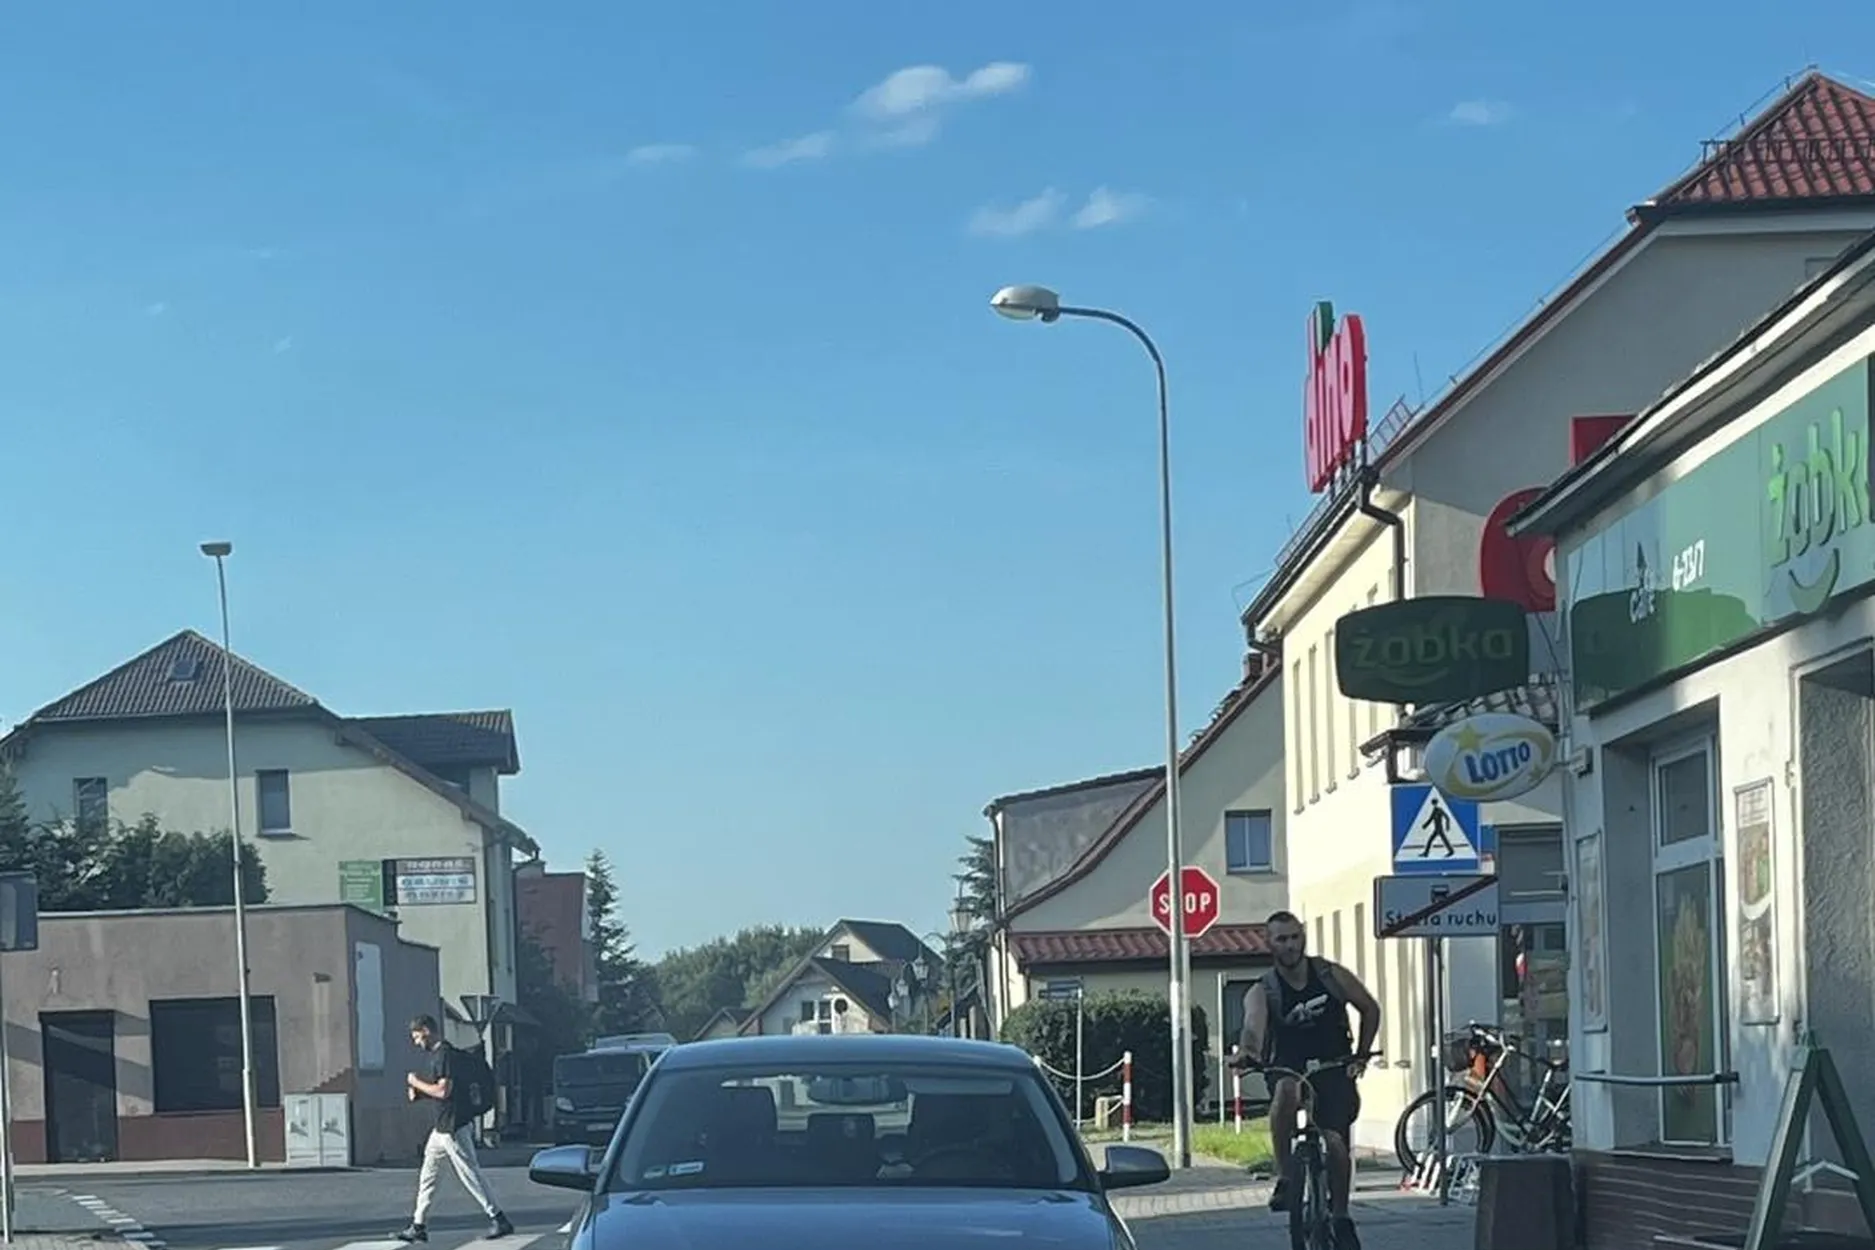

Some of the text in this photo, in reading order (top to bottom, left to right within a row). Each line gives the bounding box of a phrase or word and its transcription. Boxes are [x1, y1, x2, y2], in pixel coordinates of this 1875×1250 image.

[1352, 623, 1513, 669] żabka
[1465, 741, 1532, 784] LOTTO
[1158, 892, 1212, 915] SOP
[1448, 909, 1497, 927] ruchu
